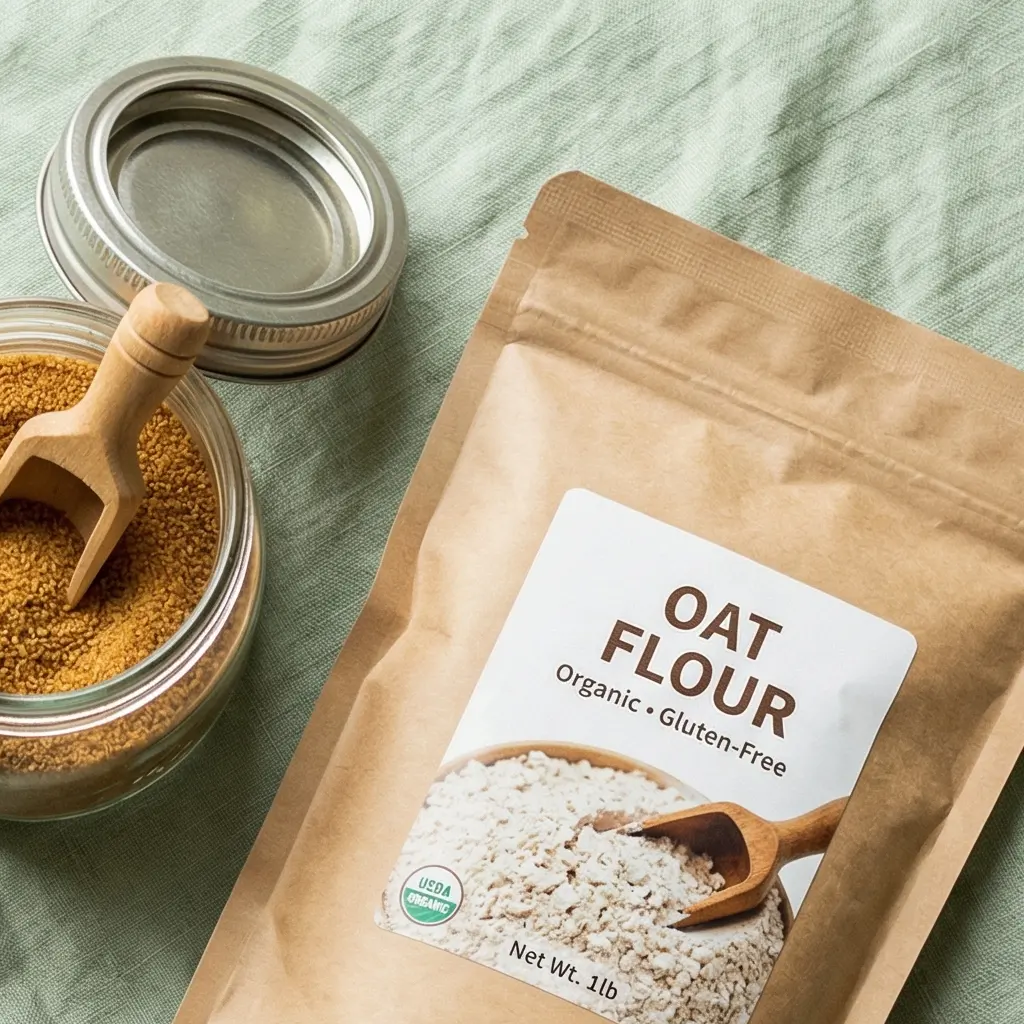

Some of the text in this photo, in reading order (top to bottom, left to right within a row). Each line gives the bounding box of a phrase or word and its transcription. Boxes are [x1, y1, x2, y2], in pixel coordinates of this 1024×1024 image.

[664, 585, 783, 661] OAT
[600, 619, 796, 739] FLOUR
[555, 663, 787, 778] Organic Gluten-Free
[419, 876, 451, 897] USDA
[509, 939, 618, 1001] Net Wt. 1lb
